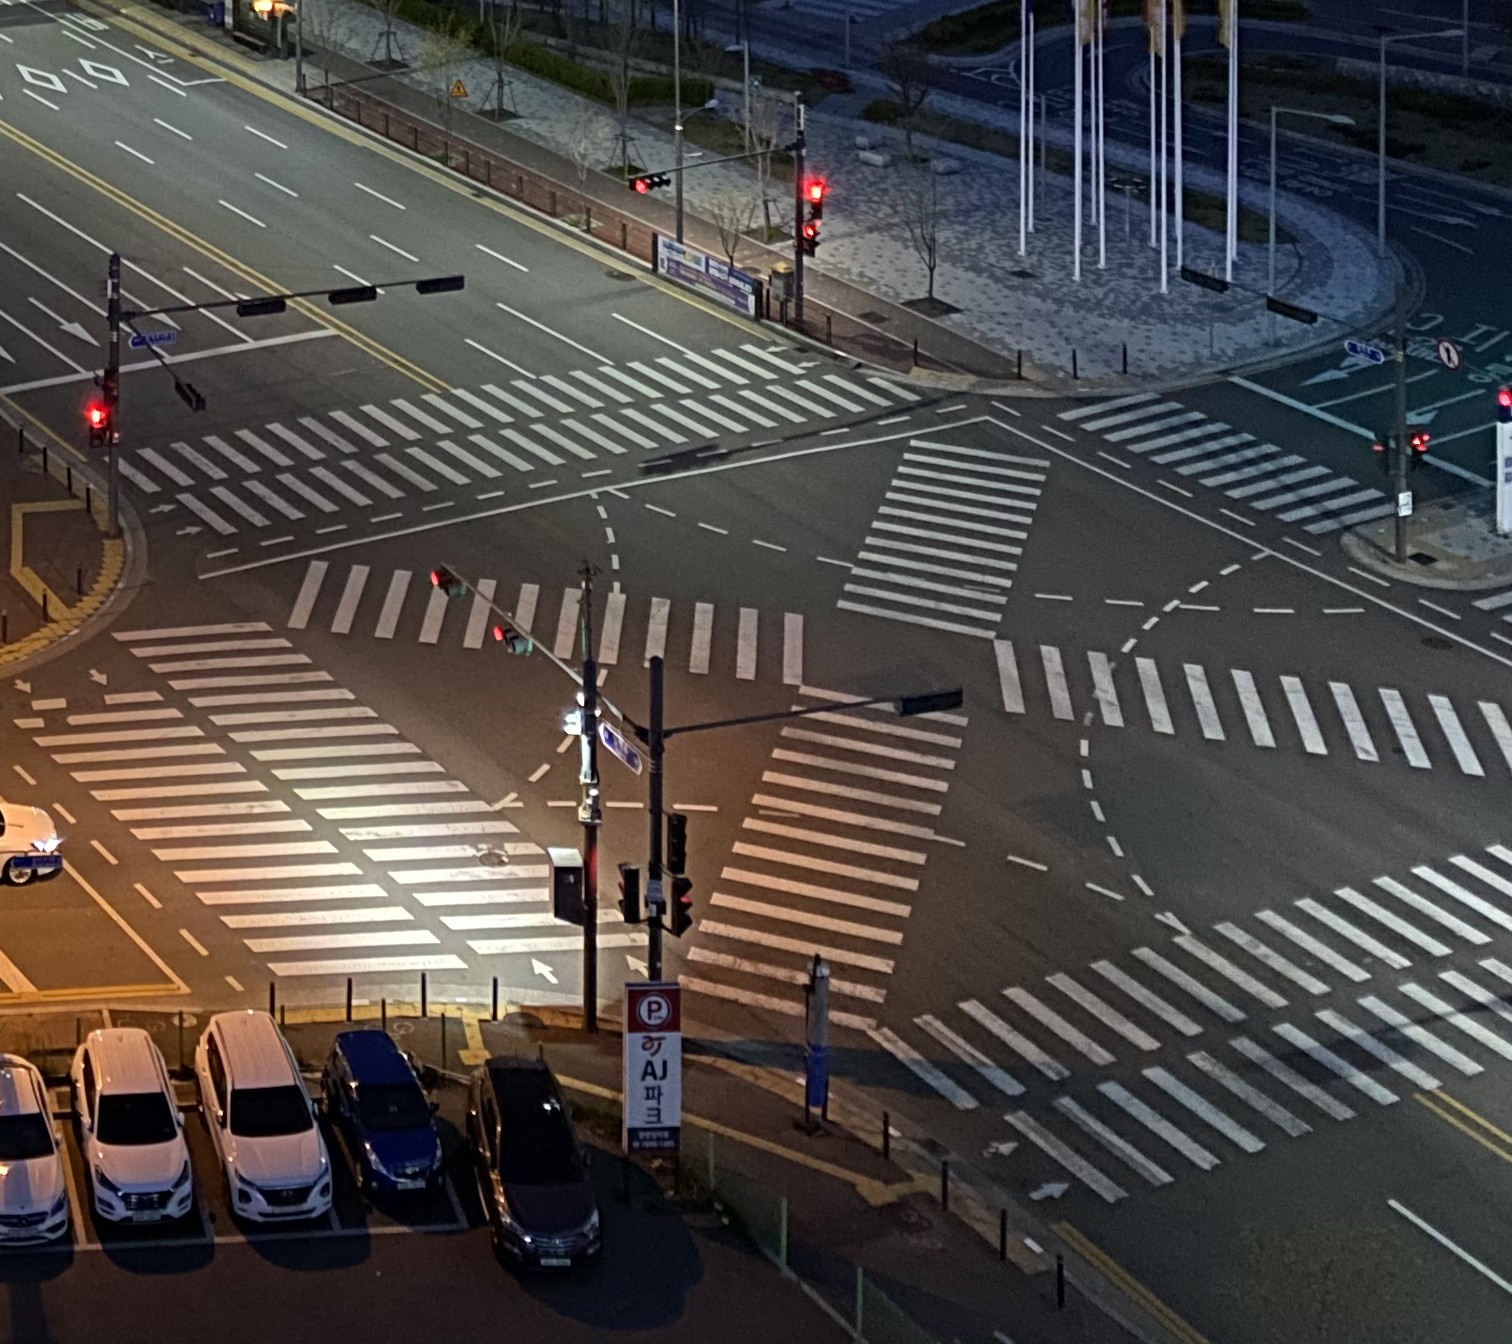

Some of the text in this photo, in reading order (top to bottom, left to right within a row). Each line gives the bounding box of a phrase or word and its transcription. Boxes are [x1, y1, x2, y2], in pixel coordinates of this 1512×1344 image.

[648, 1000, 663, 1021] P
[641, 1060, 668, 1081] AJ
[644, 1085, 664, 1124] 파크
